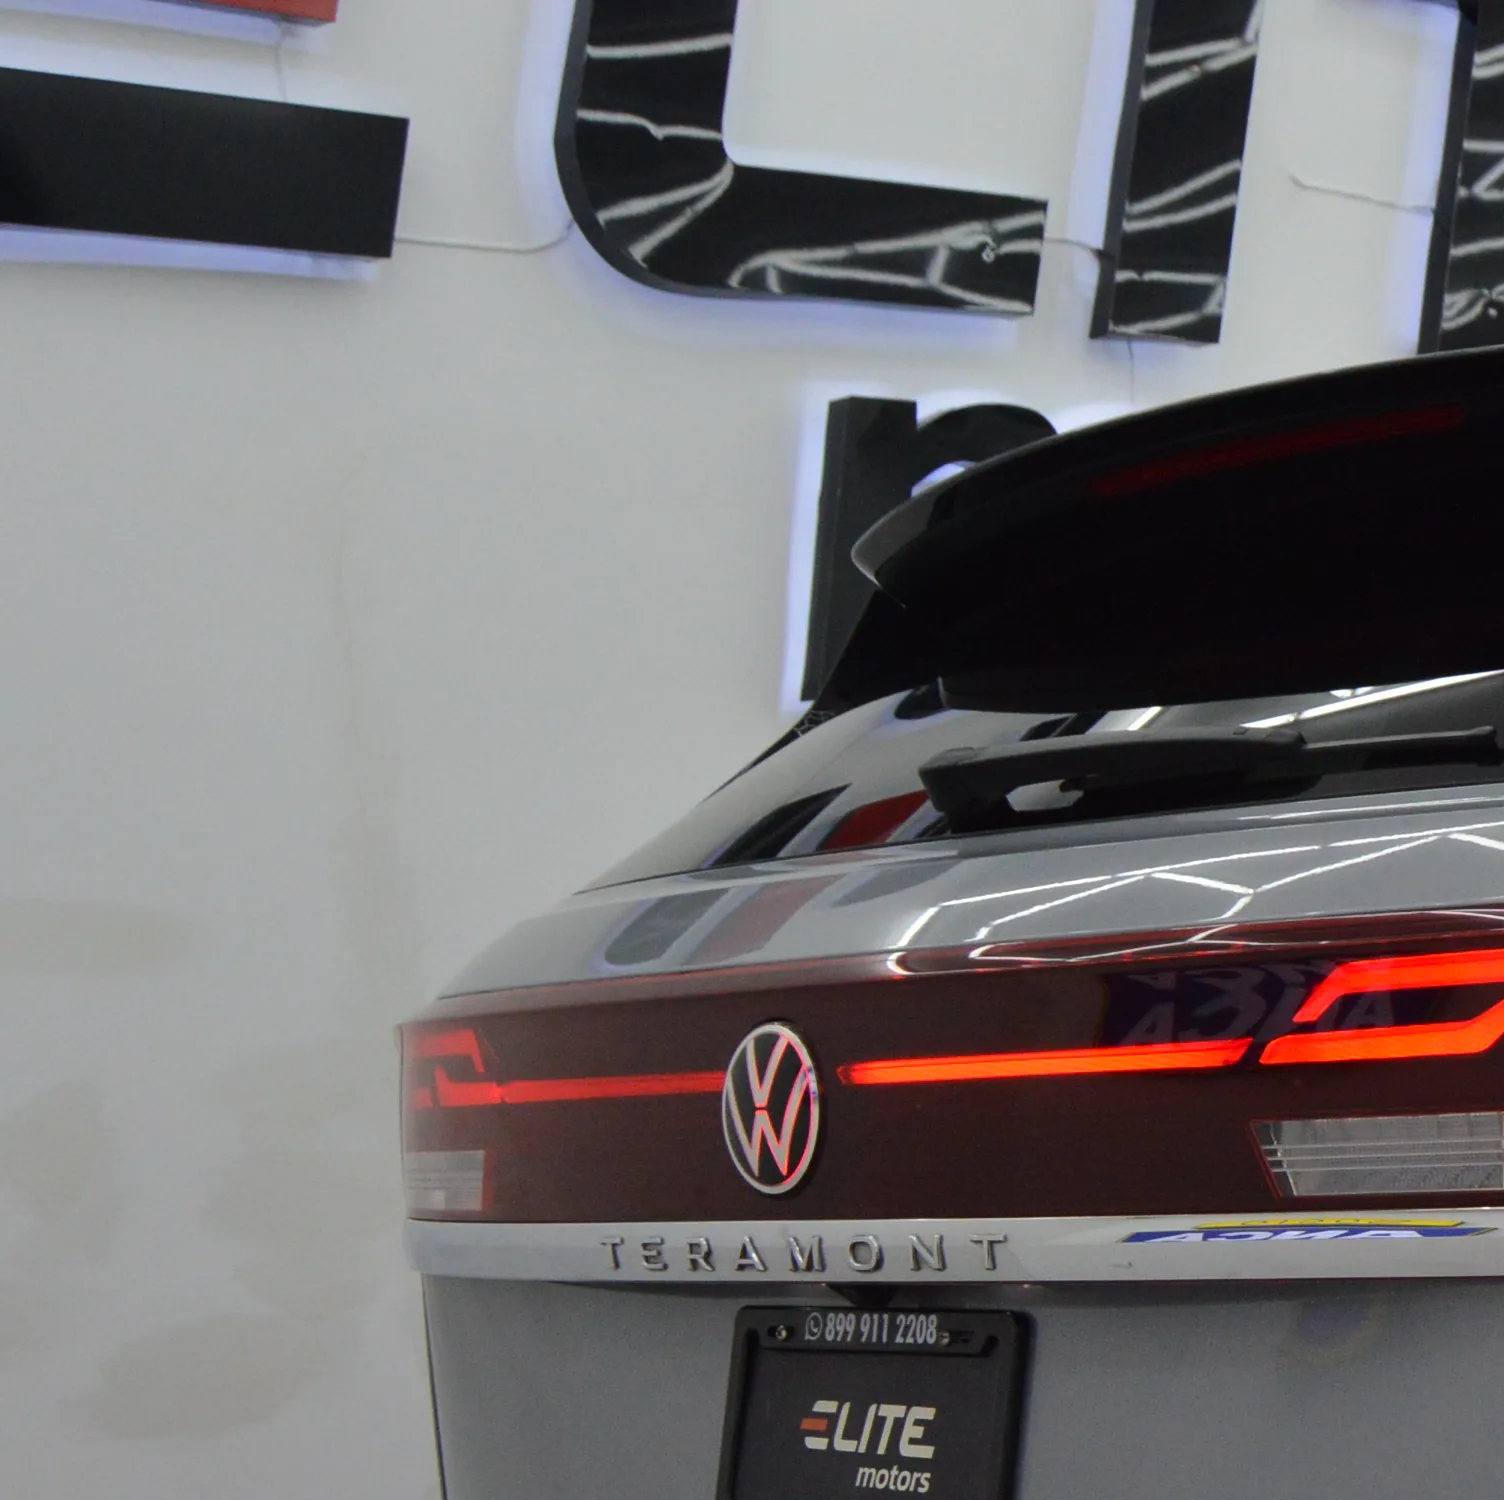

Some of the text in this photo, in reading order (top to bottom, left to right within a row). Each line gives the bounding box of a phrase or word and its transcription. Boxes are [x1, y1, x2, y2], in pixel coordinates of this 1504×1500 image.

[600, 1233, 1008, 1273] TERAMONT
[825, 1312, 938, 1345] 899 911 2208
[800, 1400, 936, 1459] ELITE
[855, 1465, 931, 1493] motors
